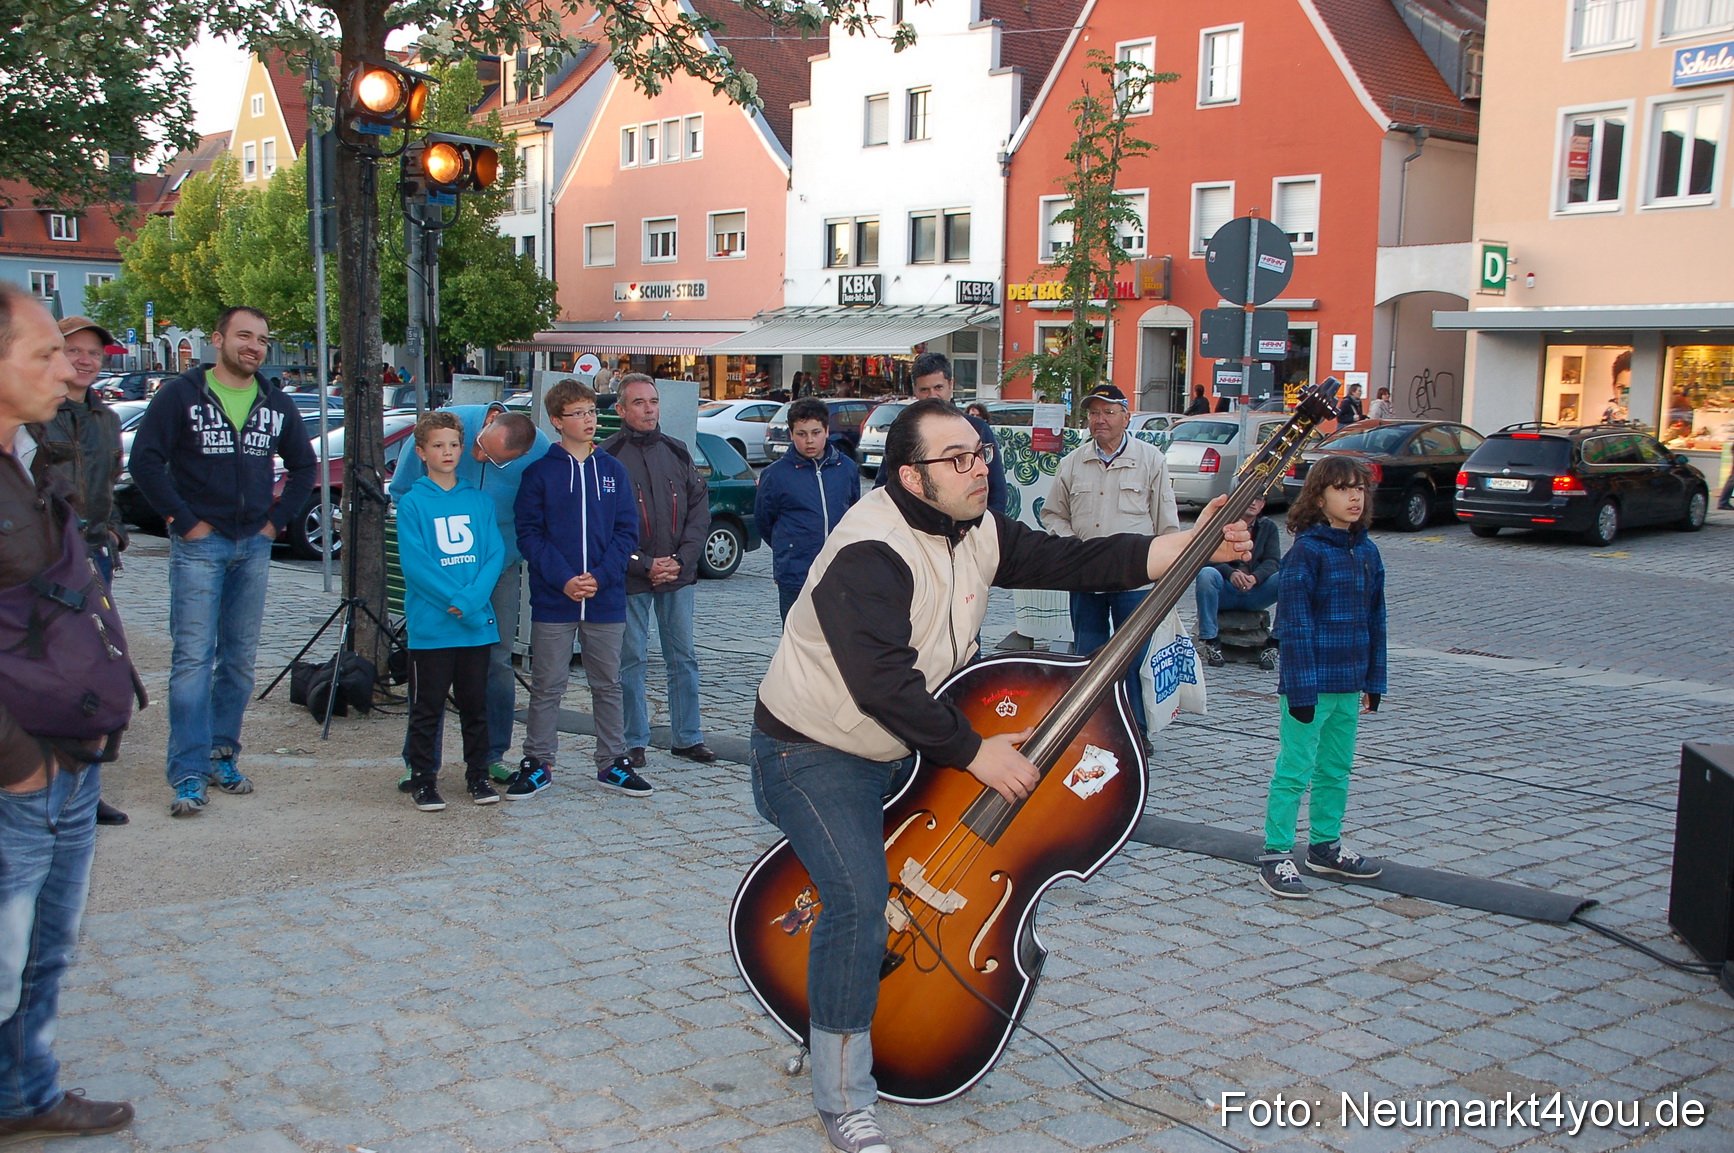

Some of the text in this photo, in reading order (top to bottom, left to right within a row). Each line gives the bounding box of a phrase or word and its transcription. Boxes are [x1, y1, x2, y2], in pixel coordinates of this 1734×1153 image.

[1676, 46, 1734, 76] Schüle
[1484, 251, 1506, 284] D
[842, 275, 876, 294] KBK
[962, 282, 993, 296] KBK
[1007, 283, 1035, 300] DER
[202, 430, 234, 446] REAL
